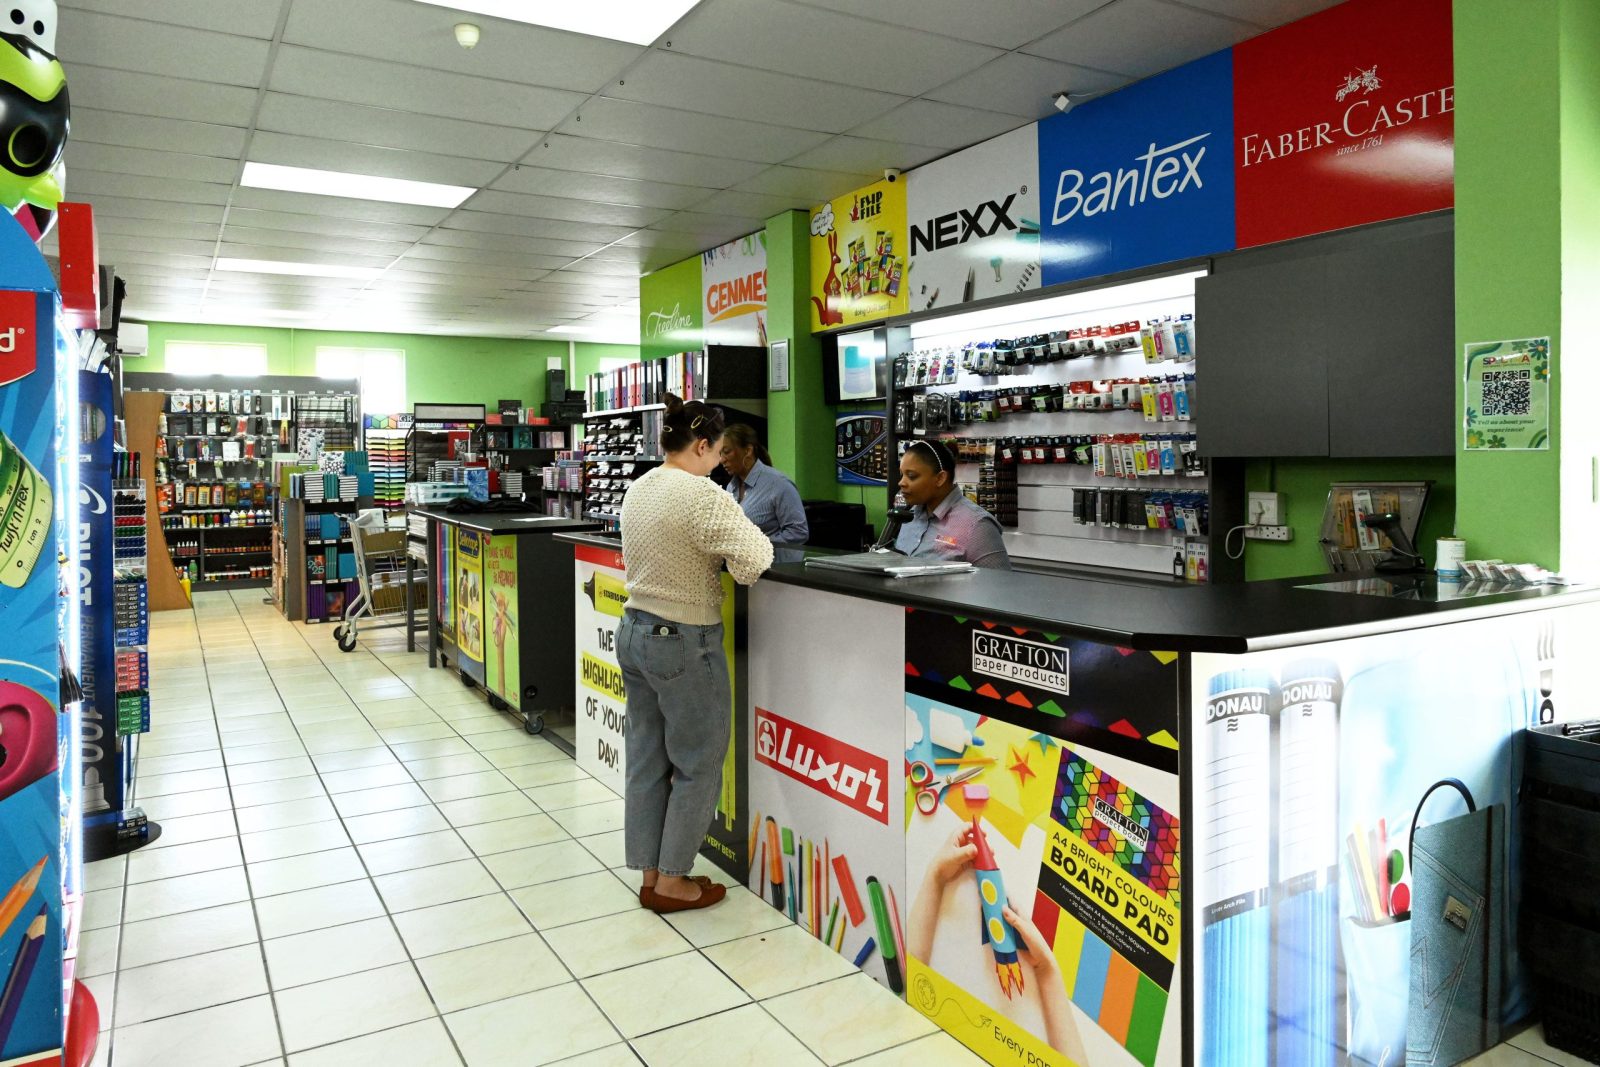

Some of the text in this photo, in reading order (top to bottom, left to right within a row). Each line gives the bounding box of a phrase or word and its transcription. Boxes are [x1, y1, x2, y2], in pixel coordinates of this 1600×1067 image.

[1336, 135, 1384, 156] since 1761
[1052, 132, 1212, 226] Bantex
[861, 191, 883, 208] FLIP
[861, 203, 881, 220] FILE
[910, 193, 1018, 256] NEXX
[29, 529, 38, 541] cm
[17, 560, 23, 568] 0
[597, 627, 614, 652] THE
[975, 636, 1064, 673] GRAFTON
[975, 657, 1066, 687] paper products
[585, 695, 599, 720] OF
[1282, 684, 1332, 706] DONAU
[1207, 695, 1262, 721] DONAU
[598, 738, 619, 773] DAY!
[1095, 810, 1145, 847] project board
[1096, 800, 1147, 841] GRAFTON
[706, 833, 721, 850] VERY
[1053, 831, 1067, 847] A4
[1070, 843, 1112, 879] BRIGHT
[1115, 876, 1174, 927] COLOURS
[1050, 845, 1119, 908] BOARD
[1124, 900, 1169, 946] PAD
[1062, 884, 1081, 901] Assorted
[1223, 901, 1235, 910] Arch
[994, 1026, 1024, 1058] Every
